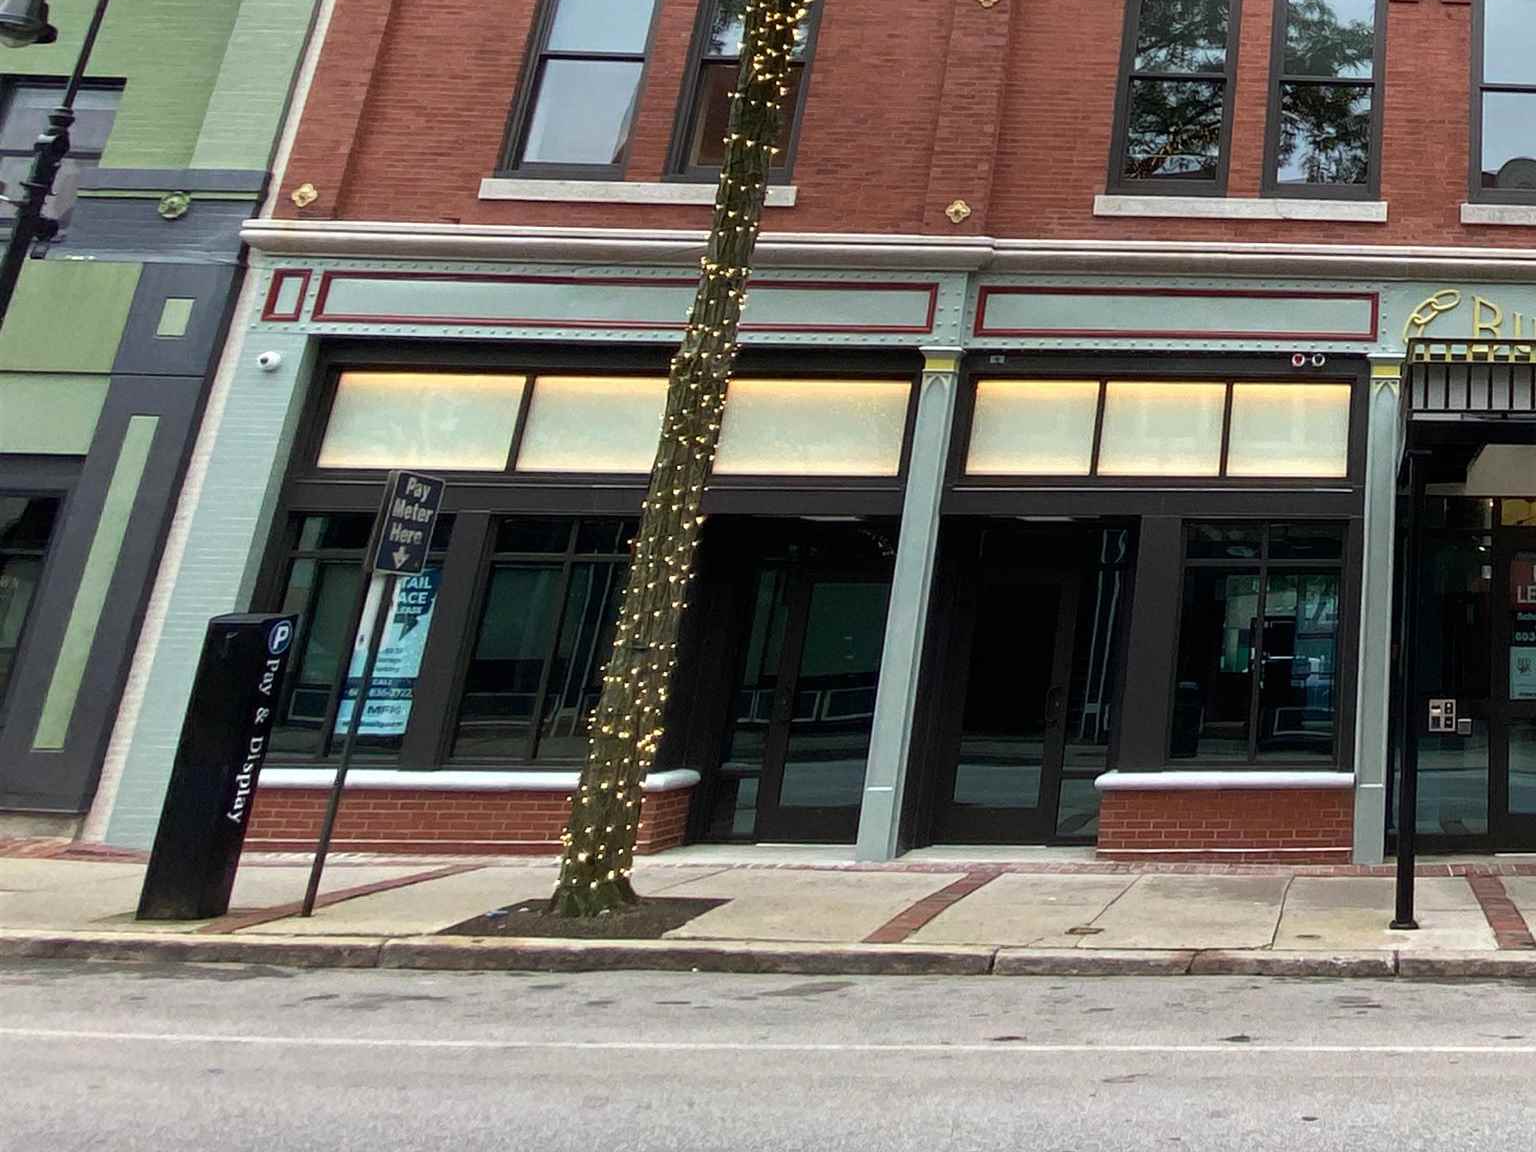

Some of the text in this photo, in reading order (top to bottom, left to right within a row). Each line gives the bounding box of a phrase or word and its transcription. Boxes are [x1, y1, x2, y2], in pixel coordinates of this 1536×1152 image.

[405, 476, 432, 503] Pay
[391, 497, 434, 523] Meter
[389, 522, 423, 545] Here
[400, 575, 432, 590] TAIL
[398, 591, 429, 605] ACE
[273, 626, 289, 649] P
[227, 658, 280, 824] Pay & Display
